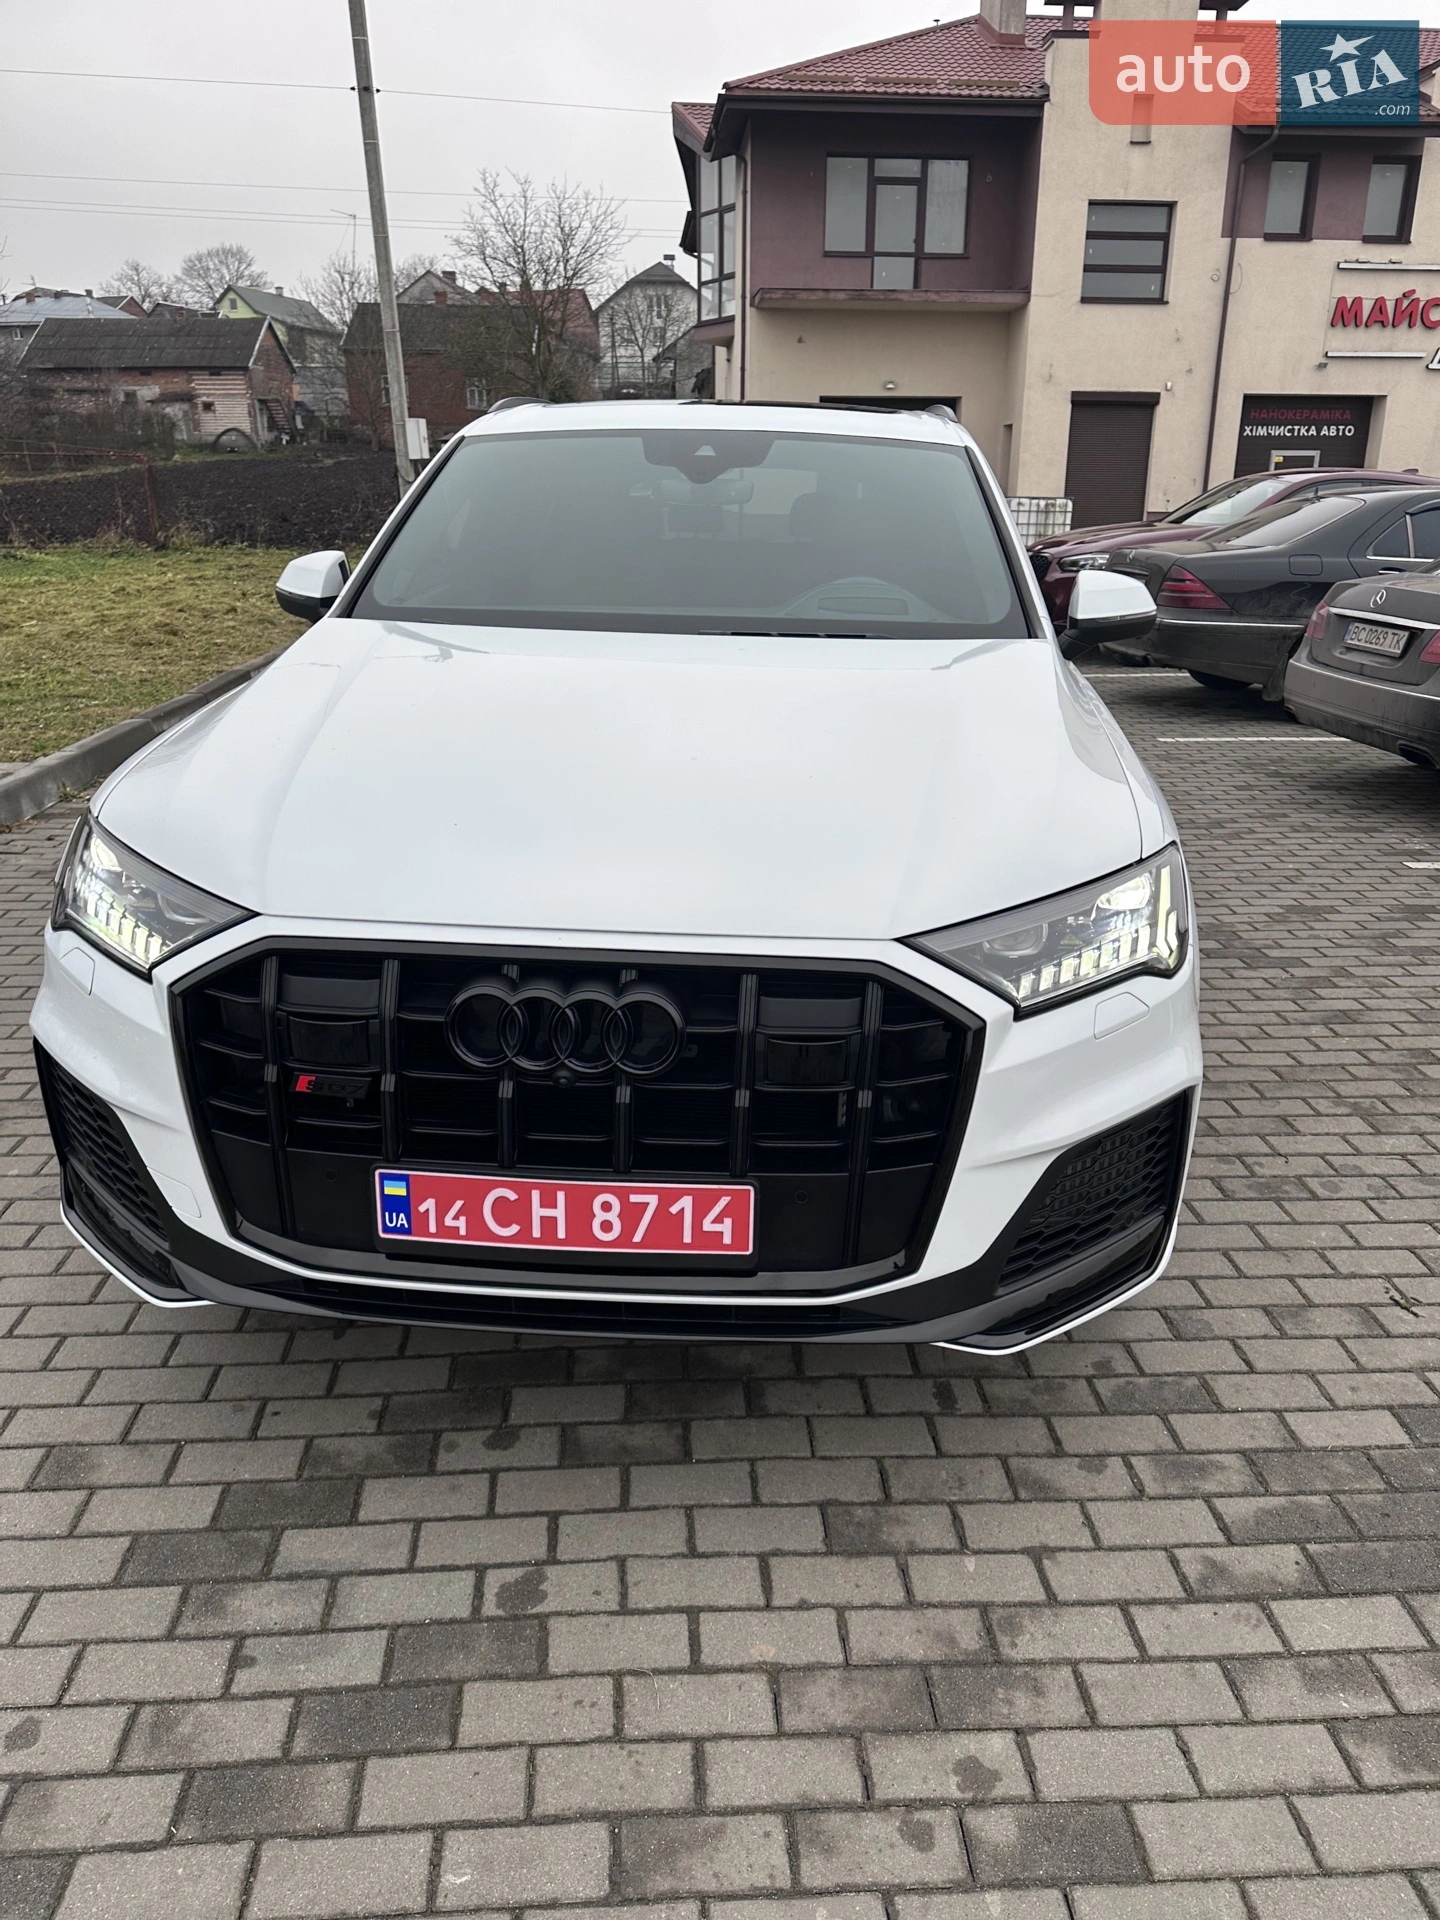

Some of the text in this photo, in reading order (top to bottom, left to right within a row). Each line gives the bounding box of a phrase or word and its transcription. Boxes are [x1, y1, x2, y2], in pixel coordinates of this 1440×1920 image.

[1250, 408, 1352, 420] НАНОКЕРАМІКА
[1243, 425, 1355, 437] ХІМЧИСТКА АВТО
[1350, 626, 1366, 642] BC
[1365, 628, 1388, 647] 0269
[384, 1211, 409, 1229] UA
[417, 1187, 733, 1245] 14 CH 8714
